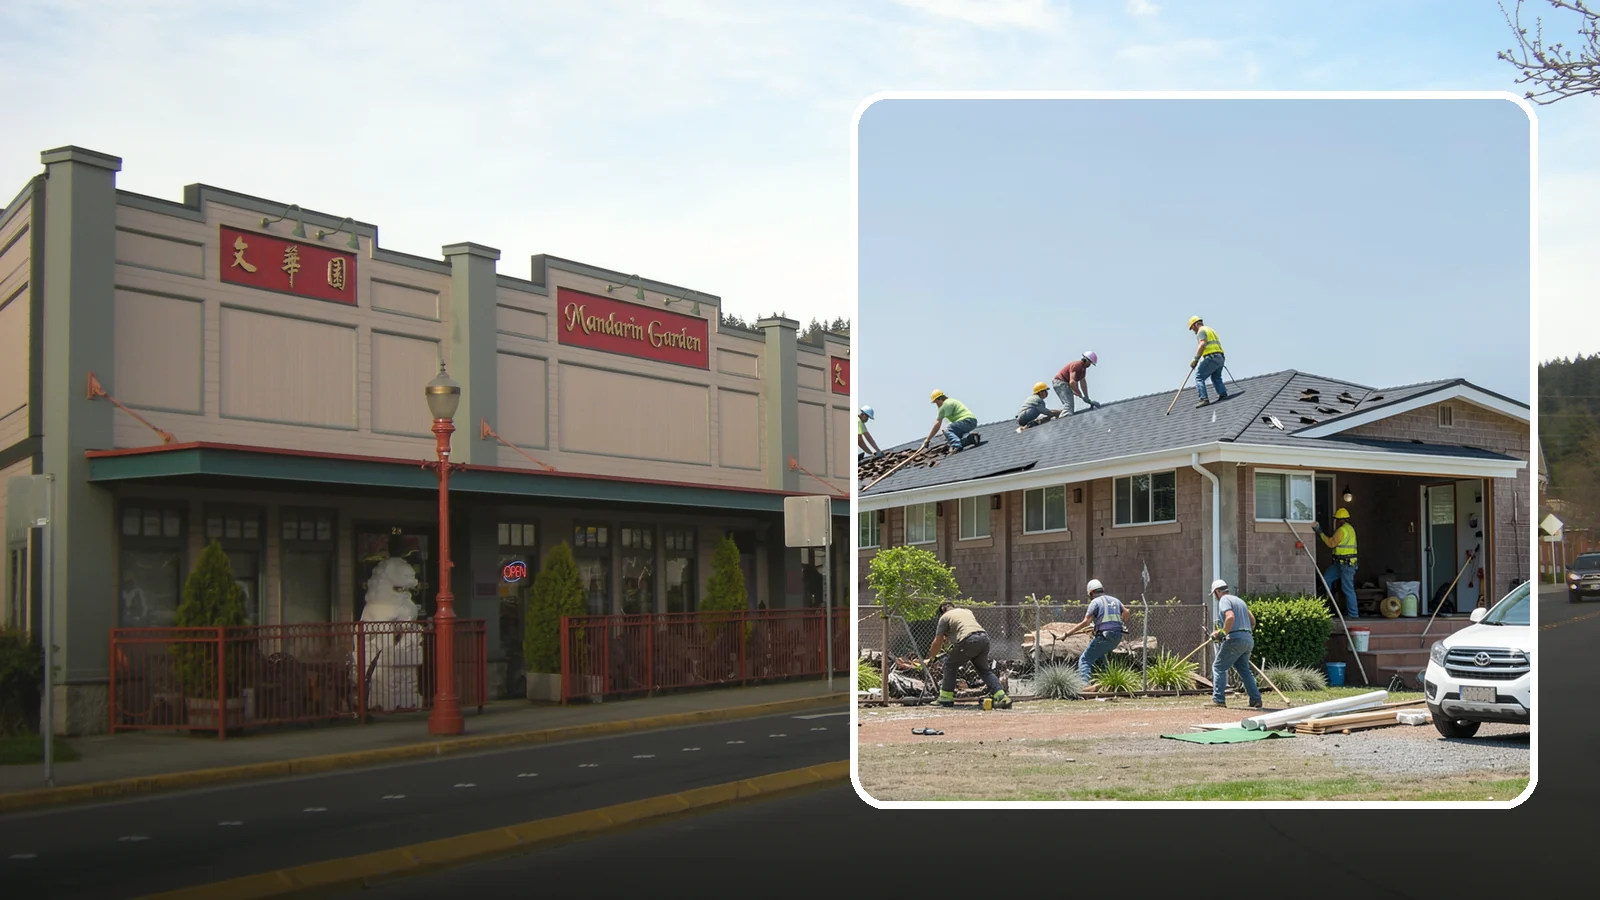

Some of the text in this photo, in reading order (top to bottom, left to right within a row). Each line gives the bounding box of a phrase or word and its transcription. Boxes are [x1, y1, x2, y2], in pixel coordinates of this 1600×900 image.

[230, 235, 346, 290] 文華園
[564, 302, 701, 352] Mandarin Garden
[503, 565, 527, 578] OPEN
